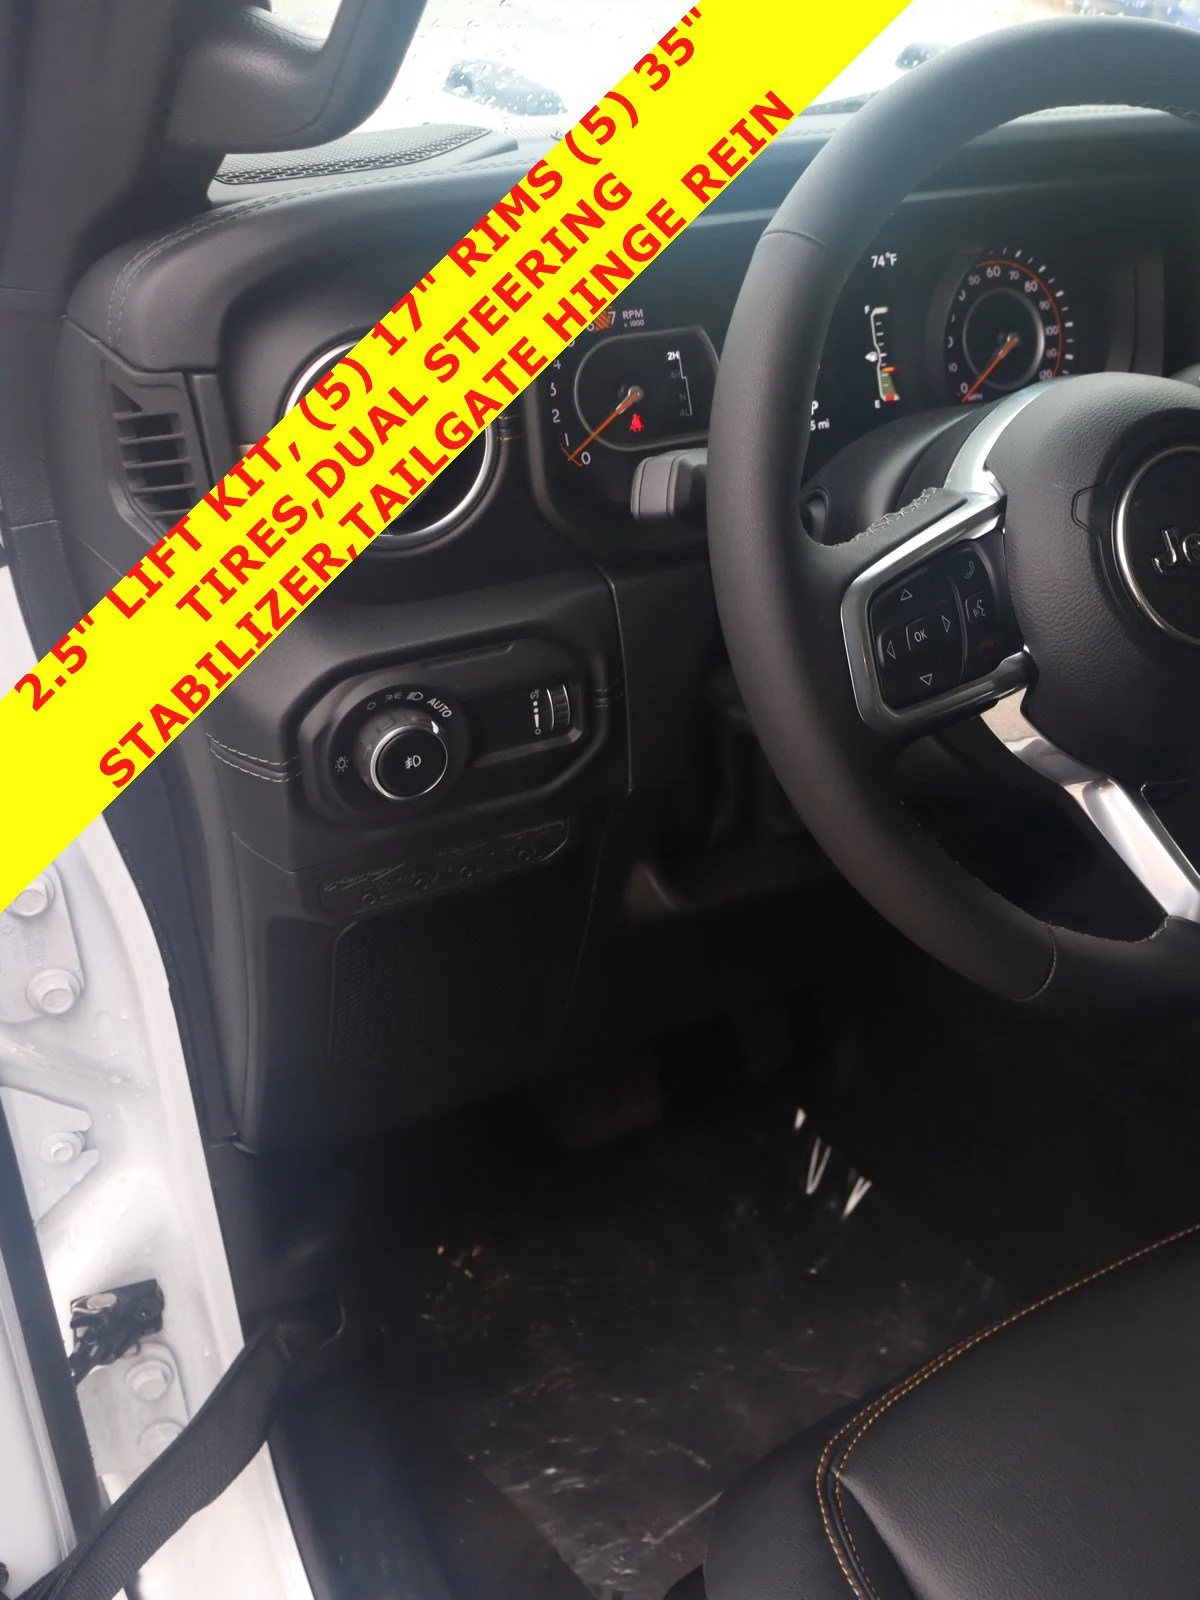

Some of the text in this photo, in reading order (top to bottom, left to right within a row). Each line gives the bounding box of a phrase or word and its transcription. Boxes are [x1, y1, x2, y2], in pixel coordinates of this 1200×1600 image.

[871, 252, 898, 268] 74°F
[986, 265, 1001, 278] 60
[1009, 270, 1020, 281] 70
[968, 275, 981, 286] 50
[1024, 280, 1038, 293] 80
[1039, 300, 1050, 311] 90
[607, 310, 617, 325] 7
[622, 308, 644, 320] RPM
[629, 319, 645, 328] 1000
[1045, 325, 1059, 336] 100
[667, 350, 680, 361] 2H
[552, 359, 562, 370] 4
[960, 381, 969, 394] 0
[811, 400, 819, 416] P
[551, 409, 561, 424] 2
[818, 417, 830, 430] mi
[580, 451, 592, 466] 0
[913, 628, 928, 643] OK
[426, 697, 453, 719] AUTO
